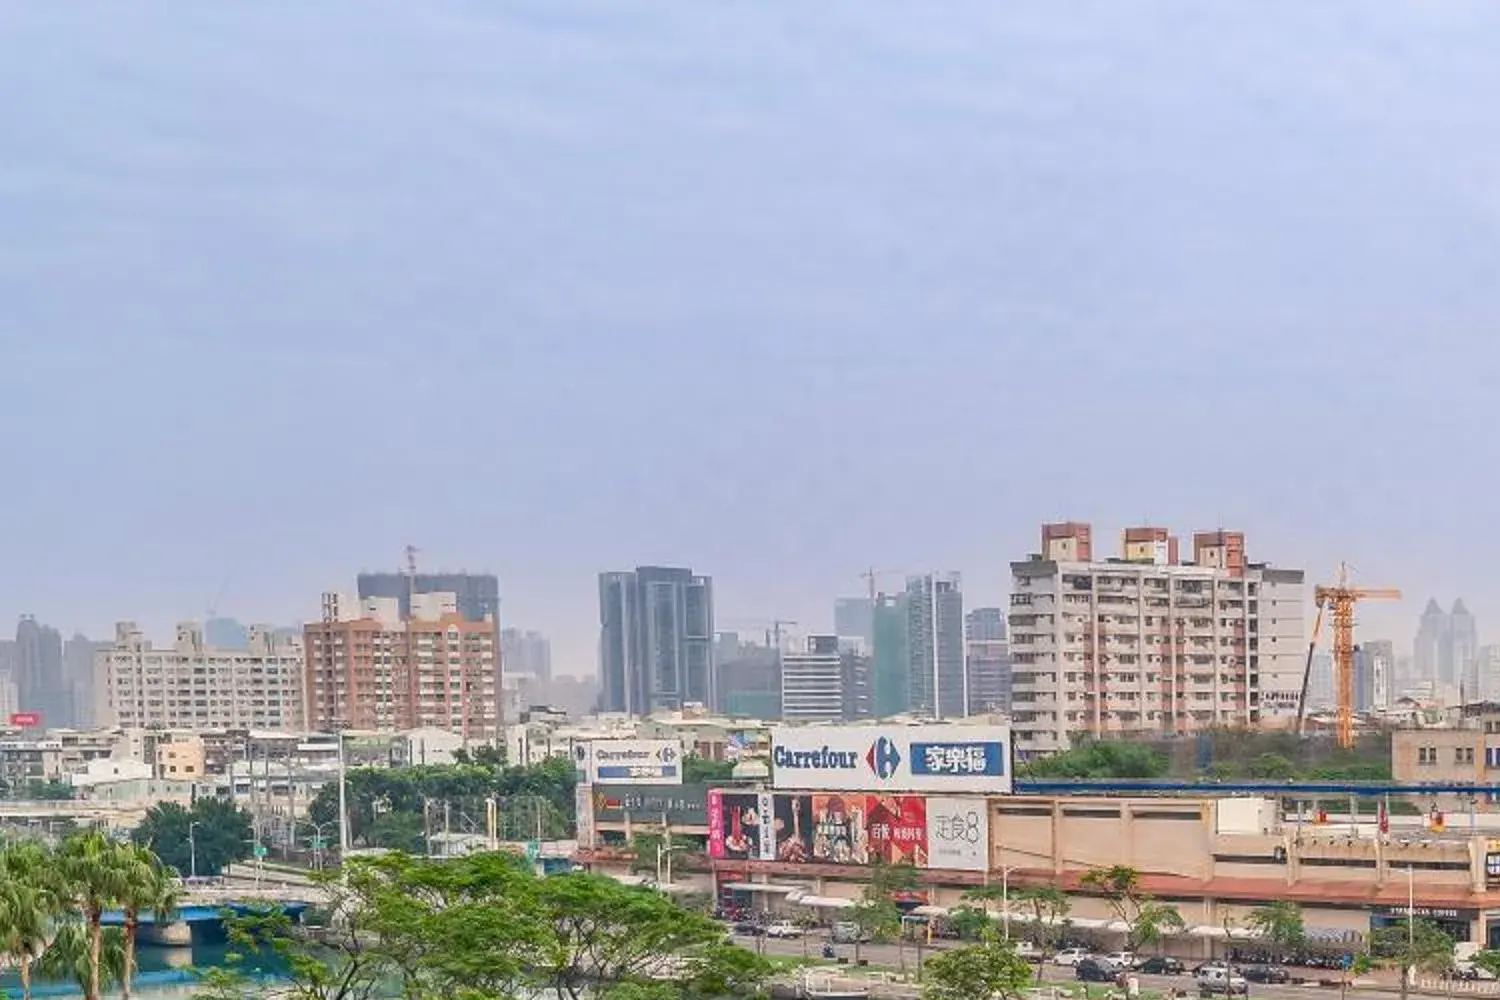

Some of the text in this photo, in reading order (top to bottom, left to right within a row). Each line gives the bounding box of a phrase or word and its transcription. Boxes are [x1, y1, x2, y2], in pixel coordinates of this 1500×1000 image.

[774, 745, 858, 769] Carrefour
[924, 745, 987, 773] 家樂福
